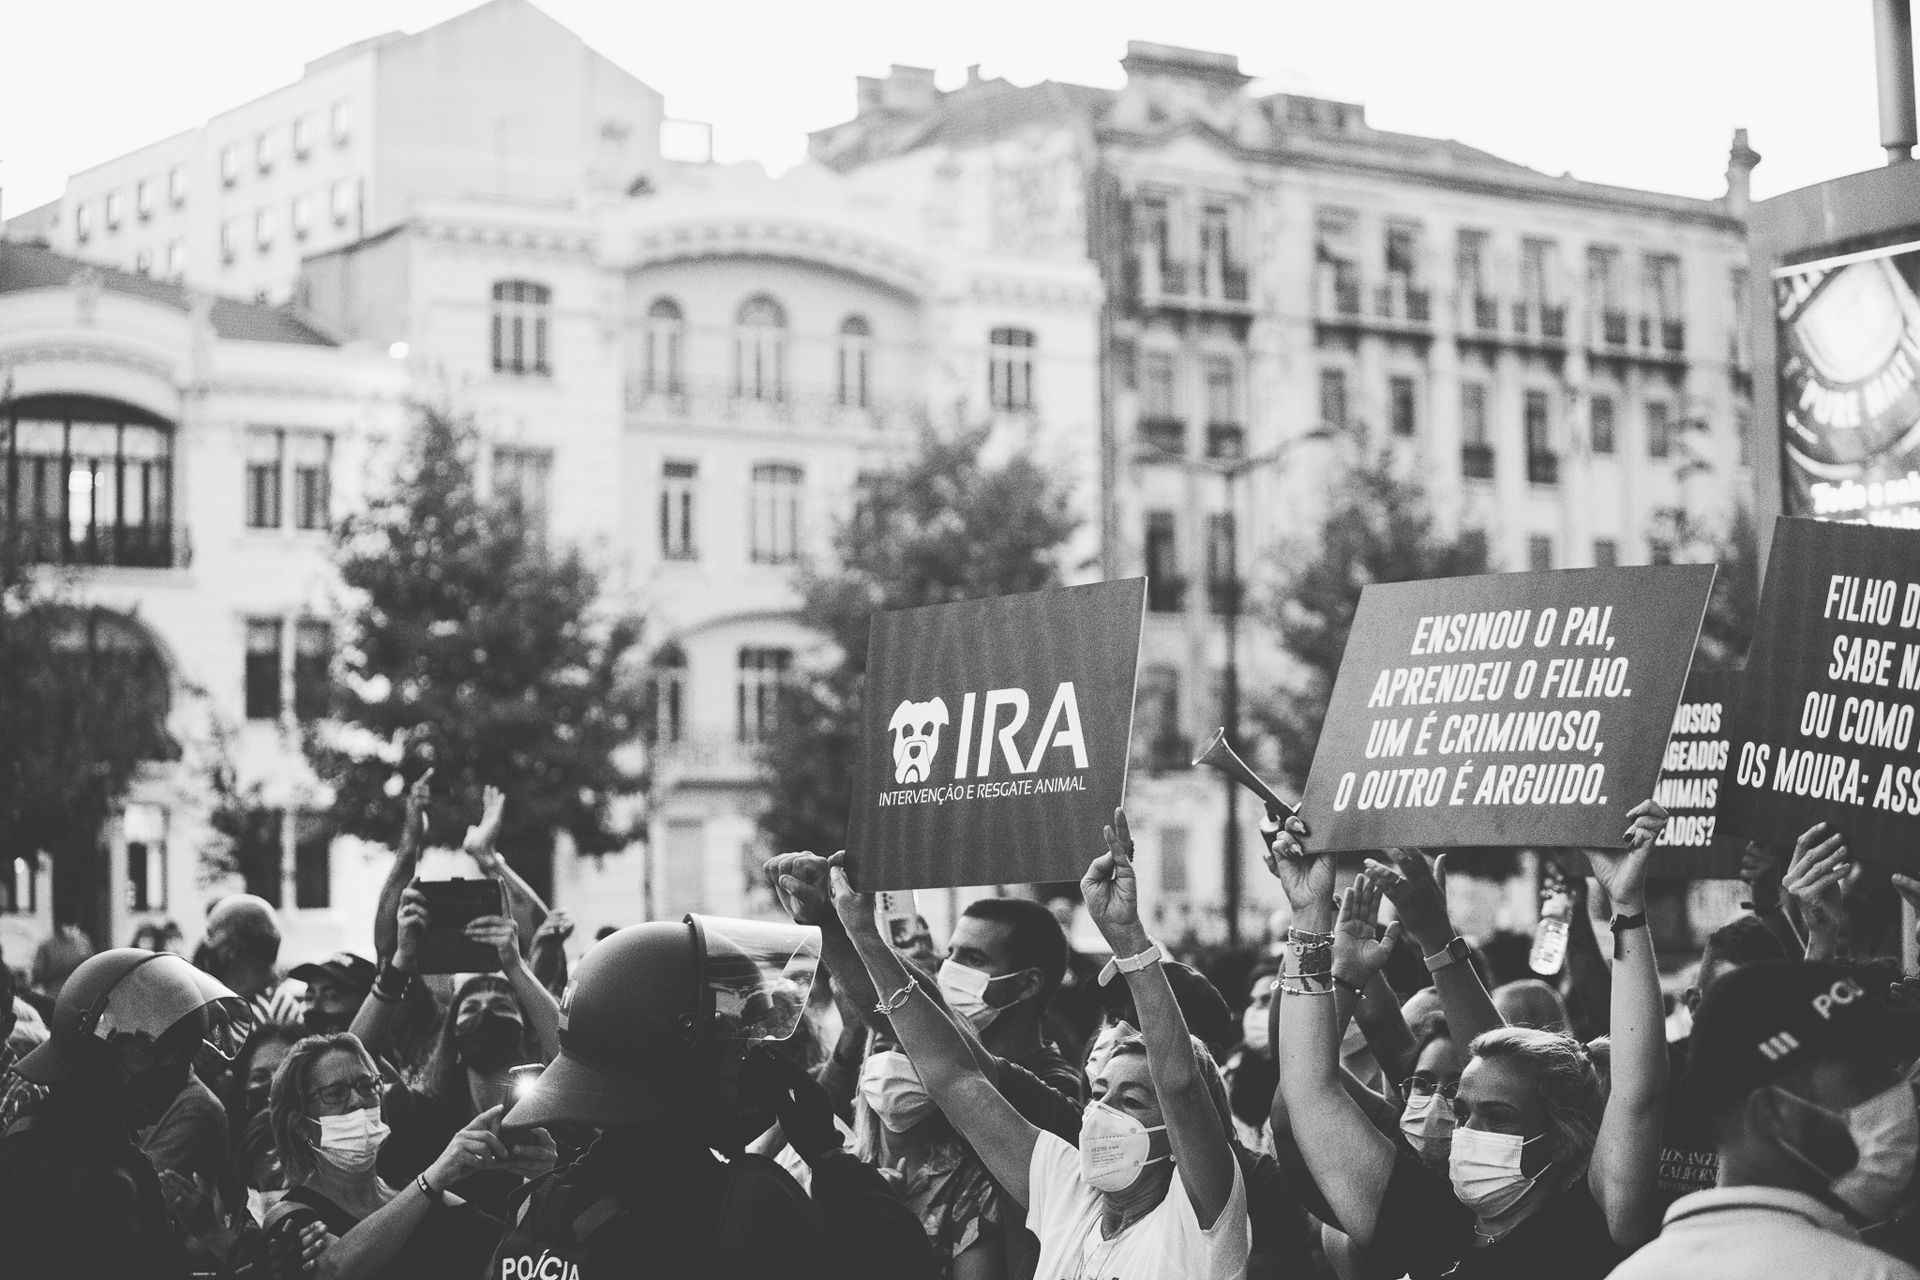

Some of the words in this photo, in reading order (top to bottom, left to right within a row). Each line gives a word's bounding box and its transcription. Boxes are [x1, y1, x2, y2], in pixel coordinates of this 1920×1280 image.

[1823, 574, 1898, 626] FILHO
[1899, 582, 1920, 629] D
[1410, 608, 1532, 657] ENSINOU
[1533, 607, 1558, 648] O
[1560, 605, 1616, 652] PAI,
[1366, 660, 1512, 709] APRENDEU
[1514, 659, 1538, 700] O
[1540, 656, 1633, 699] FILHO.
[1828, 634, 1897, 687] SABE
[955, 681, 1089, 779] IRA
[1364, 717, 1414, 760] UM
[1413, 709, 1438, 757] É
[1438, 709, 1604, 757] CRIMINOSO,
[1800, 690, 1837, 739] OU
[1838, 696, 1915, 751] COMO
[878, 783, 965, 807] INTERVENÇÃO
[966, 784, 975, 800] E
[976, 779, 1033, 799] RESGATE
[1034, 775, 1087, 794] ANIMAL
[1333, 771, 1357, 812] O
[1358, 766, 1448, 811] OUTRO
[1448, 759, 1475, 806] É
[1473, 763, 1608, 806] ARGUIDO.
[1736, 741, 1771, 789] OS
[1772, 746, 1869, 806] MOURA:
